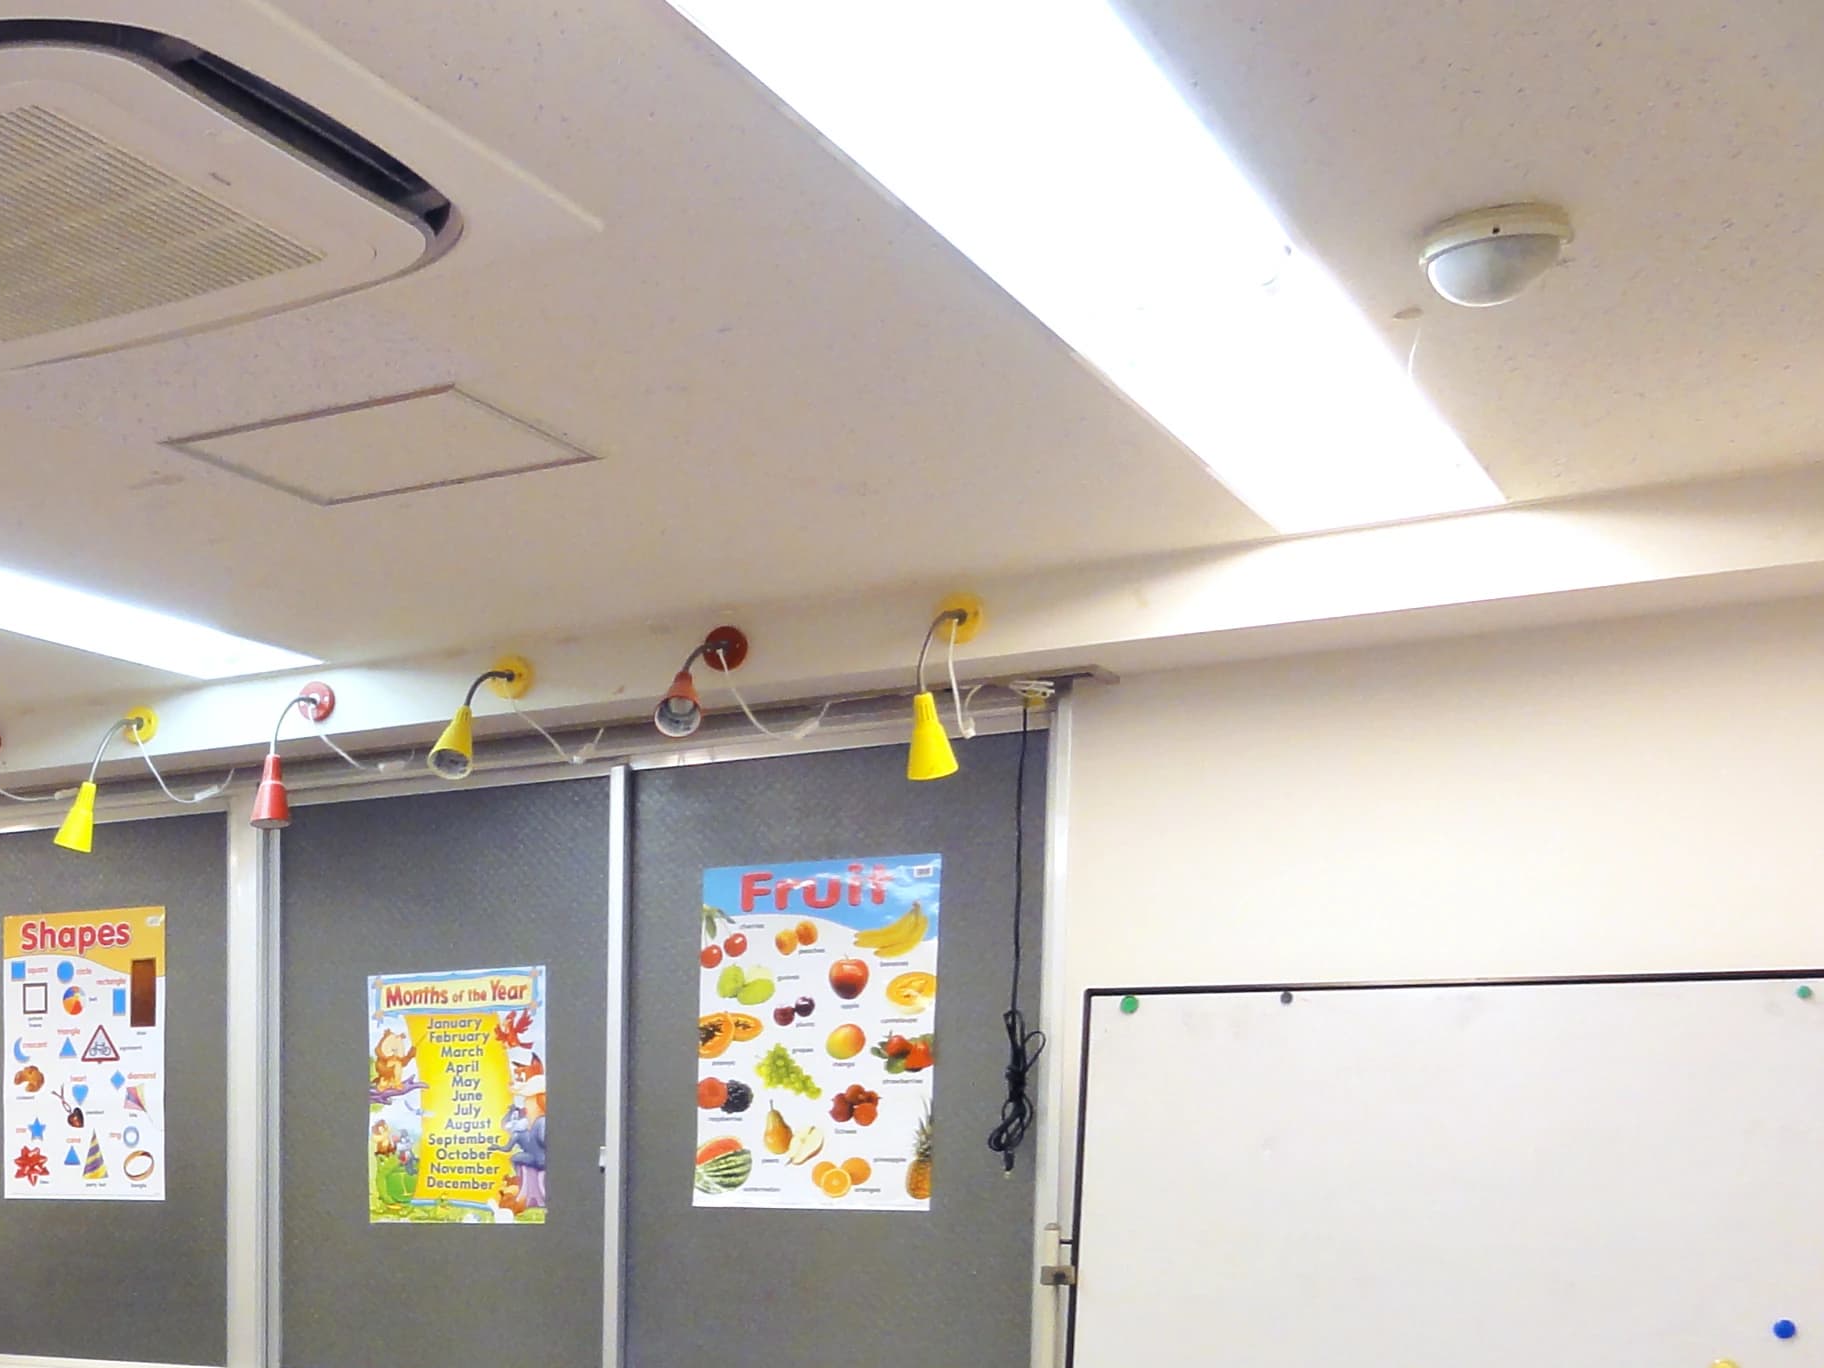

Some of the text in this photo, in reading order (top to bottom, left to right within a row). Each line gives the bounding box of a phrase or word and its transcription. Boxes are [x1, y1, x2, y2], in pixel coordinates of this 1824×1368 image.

[739, 863, 895, 913] Fruit
[21, 921, 130, 955] Shapes
[386, 980, 527, 1008] Months of the Year
[427, 1016, 482, 1031] January
[429, 1030, 490, 1045] February
[440, 1046, 483, 1057] March
[445, 1061, 479, 1075] April
[451, 1076, 480, 1090] May
[451, 1090, 483, 1102] June
[453, 1104, 481, 1118] July
[444, 1118, 491, 1133] August
[428, 1133, 501, 1148] September
[435, 1149, 492, 1161] October
[430, 1163, 499, 1175] November
[426, 1177, 495, 1190] December
